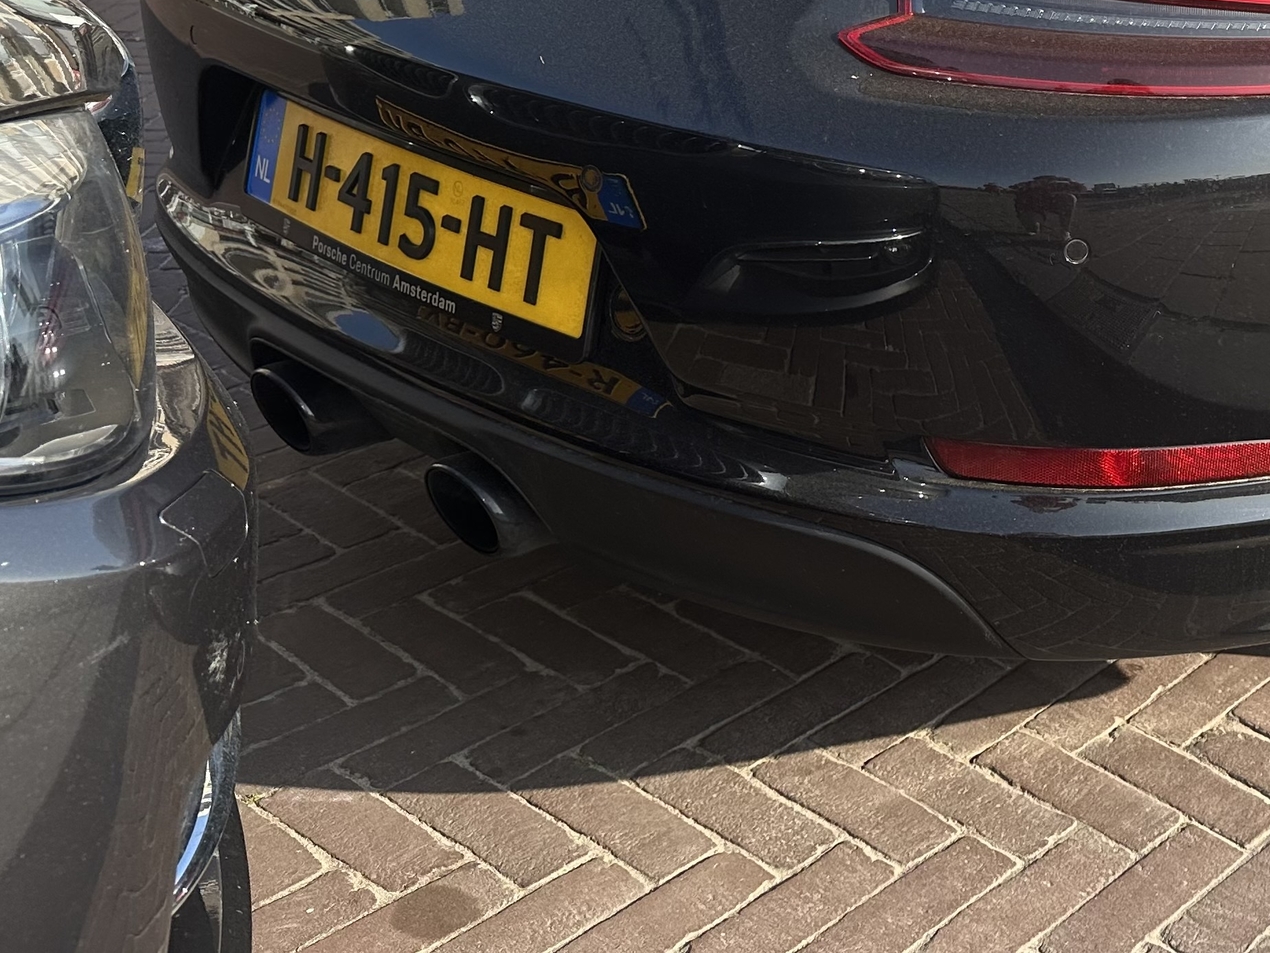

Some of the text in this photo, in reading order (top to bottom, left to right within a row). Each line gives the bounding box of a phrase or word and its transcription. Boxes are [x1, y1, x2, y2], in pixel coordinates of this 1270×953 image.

[255, 154, 271, 184] NL
[288, 123, 564, 307] H-415-HT
[312, 235, 456, 314] Porsche Centrum Amsterdam
